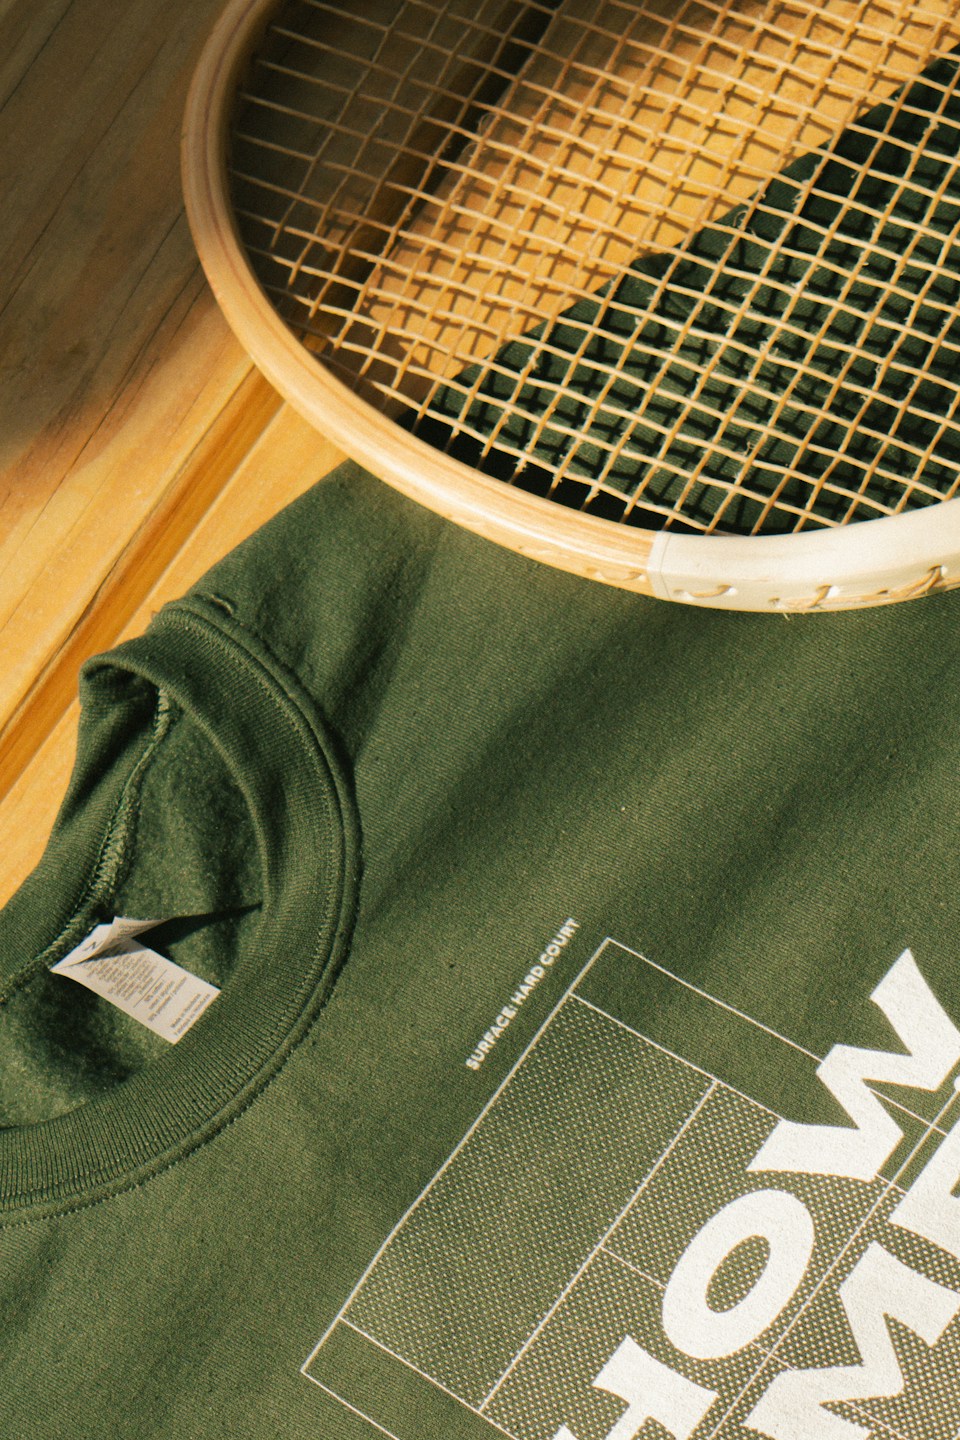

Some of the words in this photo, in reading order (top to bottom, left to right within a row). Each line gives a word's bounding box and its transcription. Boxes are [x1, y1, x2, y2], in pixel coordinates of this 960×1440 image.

[465, 1004, 519, 1071] SURFACE:
[510, 965, 546, 1006] HARD
[540, 917, 581, 967] COURT
